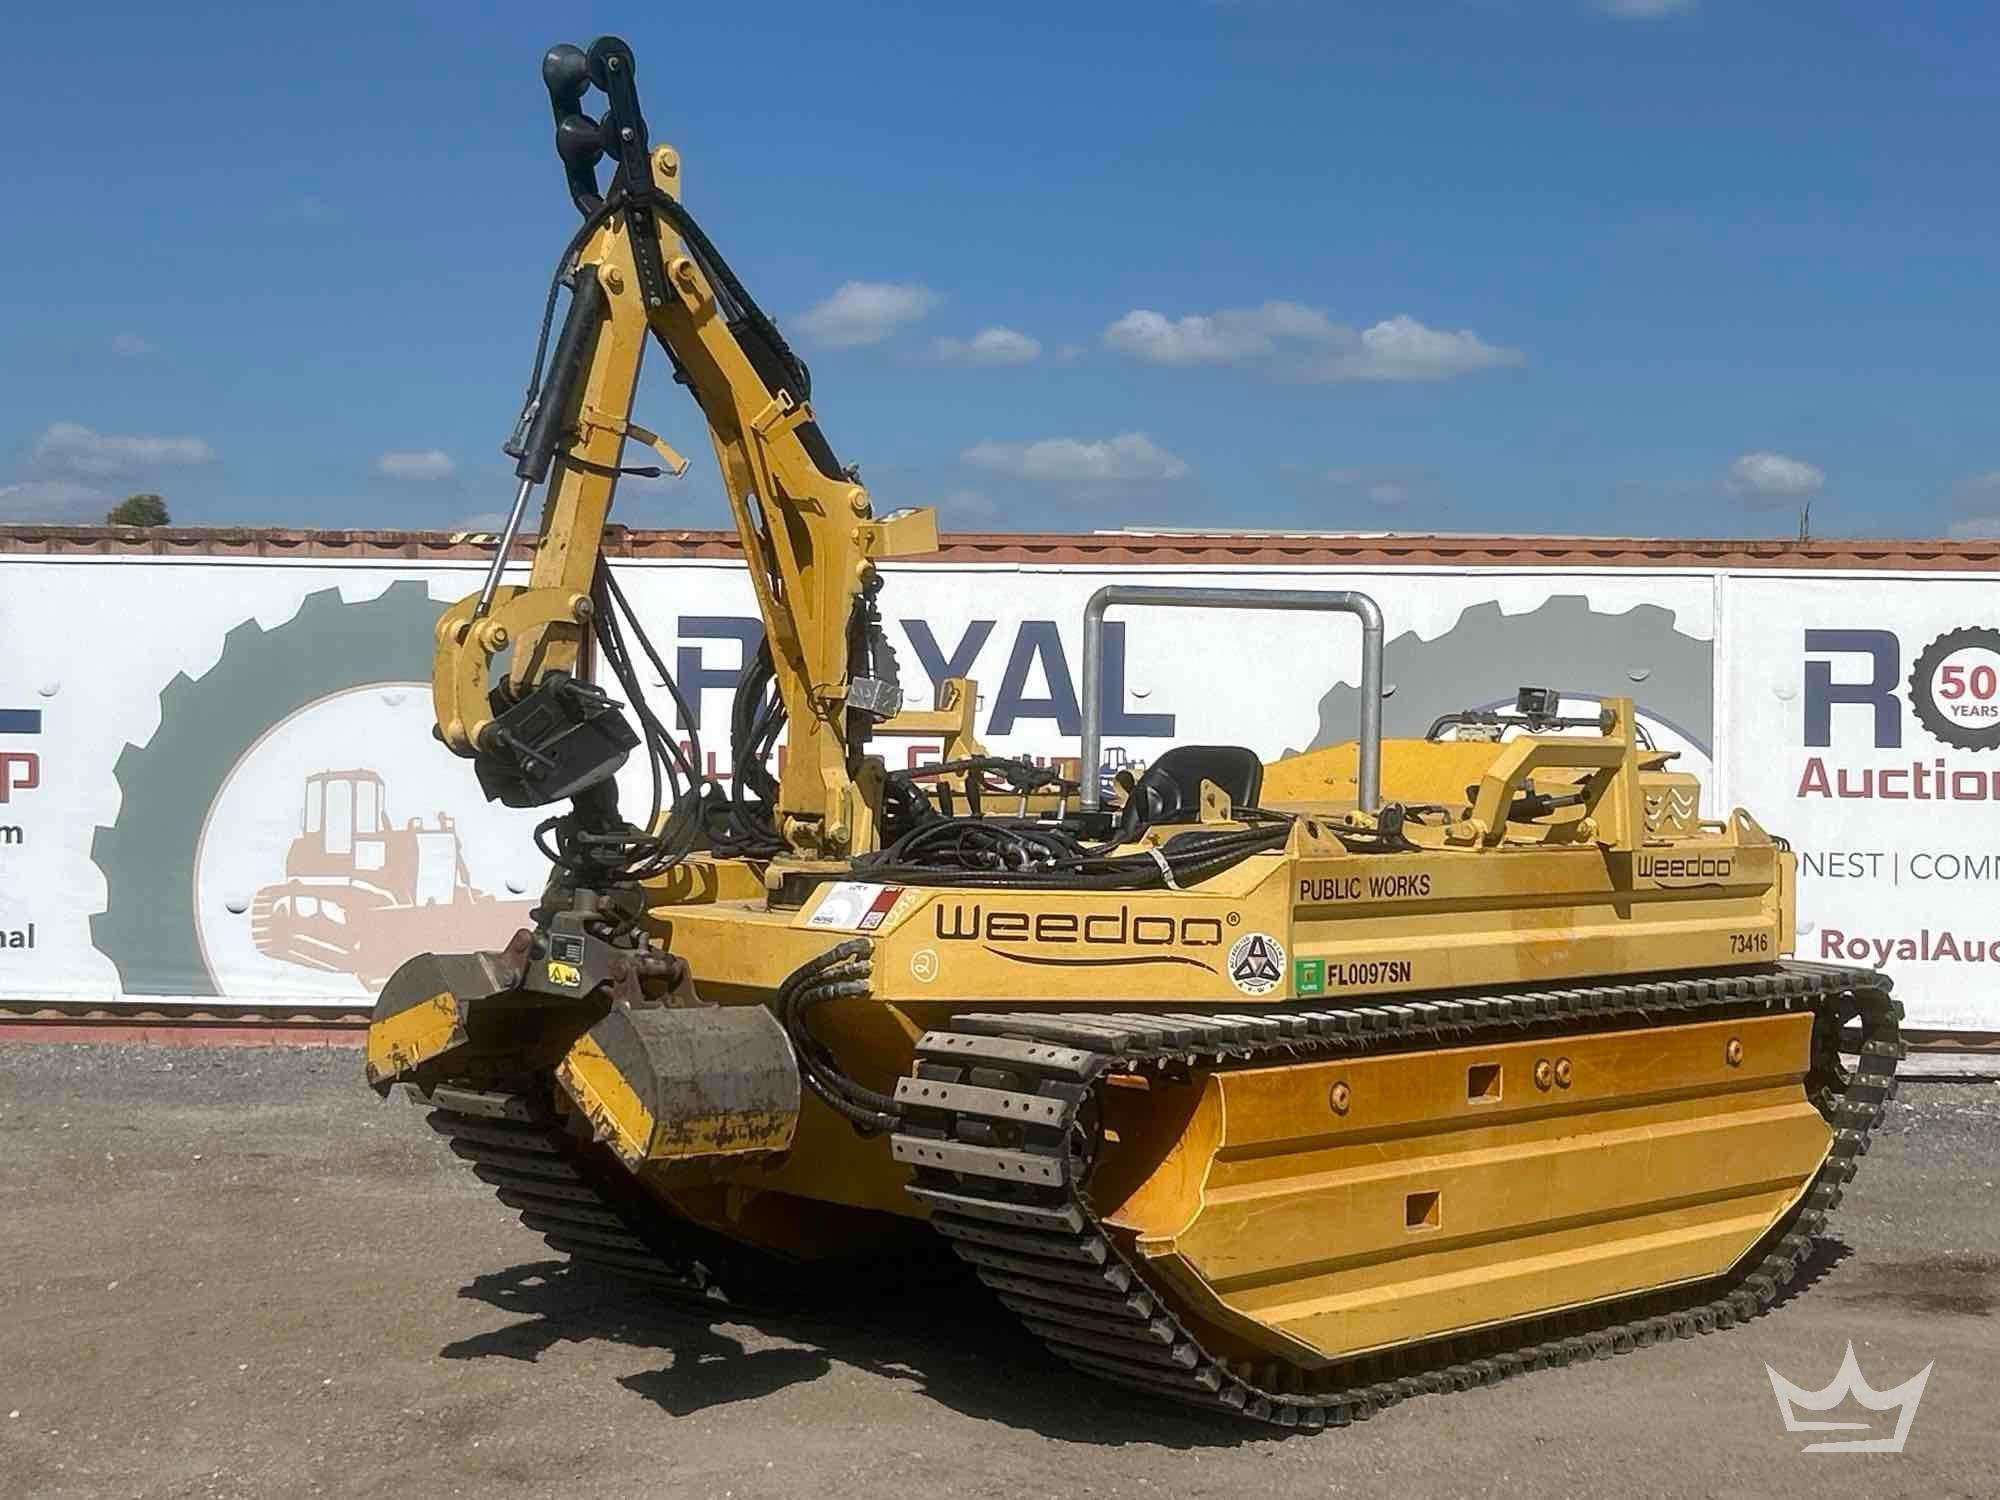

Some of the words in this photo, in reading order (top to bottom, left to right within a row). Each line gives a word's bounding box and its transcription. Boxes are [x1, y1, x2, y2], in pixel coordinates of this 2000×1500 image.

[675, 616, 1176, 738] RYAL
[1939, 666, 1997, 700] 50
[1950, 703, 1999, 718] YEARS
[1795, 851, 1884, 878] NEST
[1910, 853, 2000, 880] COM
[1300, 877, 1361, 901] PUBLIC
[1369, 874, 1431, 897] WORKS
[1730, 933, 1768, 954] 73416
[1327, 961, 1411, 986] FL0097SN
